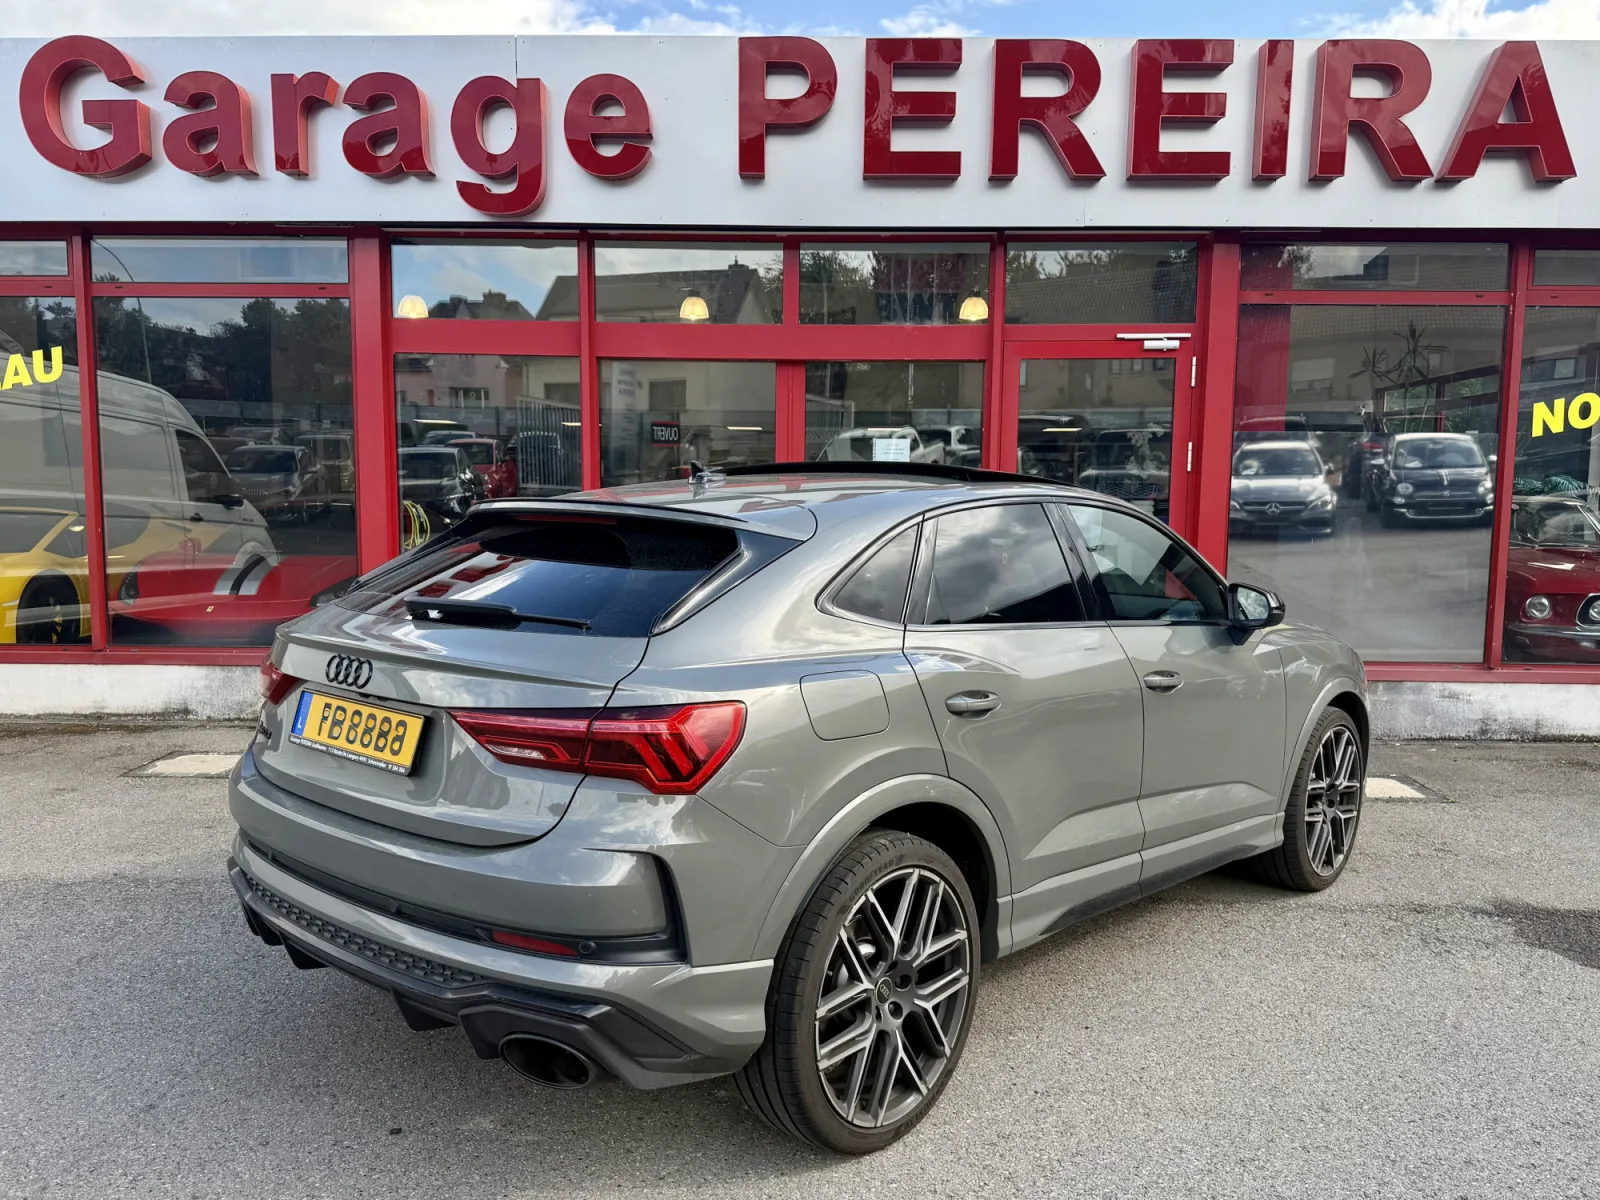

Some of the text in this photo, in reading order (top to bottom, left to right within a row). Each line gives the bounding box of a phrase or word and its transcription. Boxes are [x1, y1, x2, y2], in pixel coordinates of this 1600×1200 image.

[19, 35, 1577, 217] Garage PEREIRA
[0, 345, 63, 390] AU
